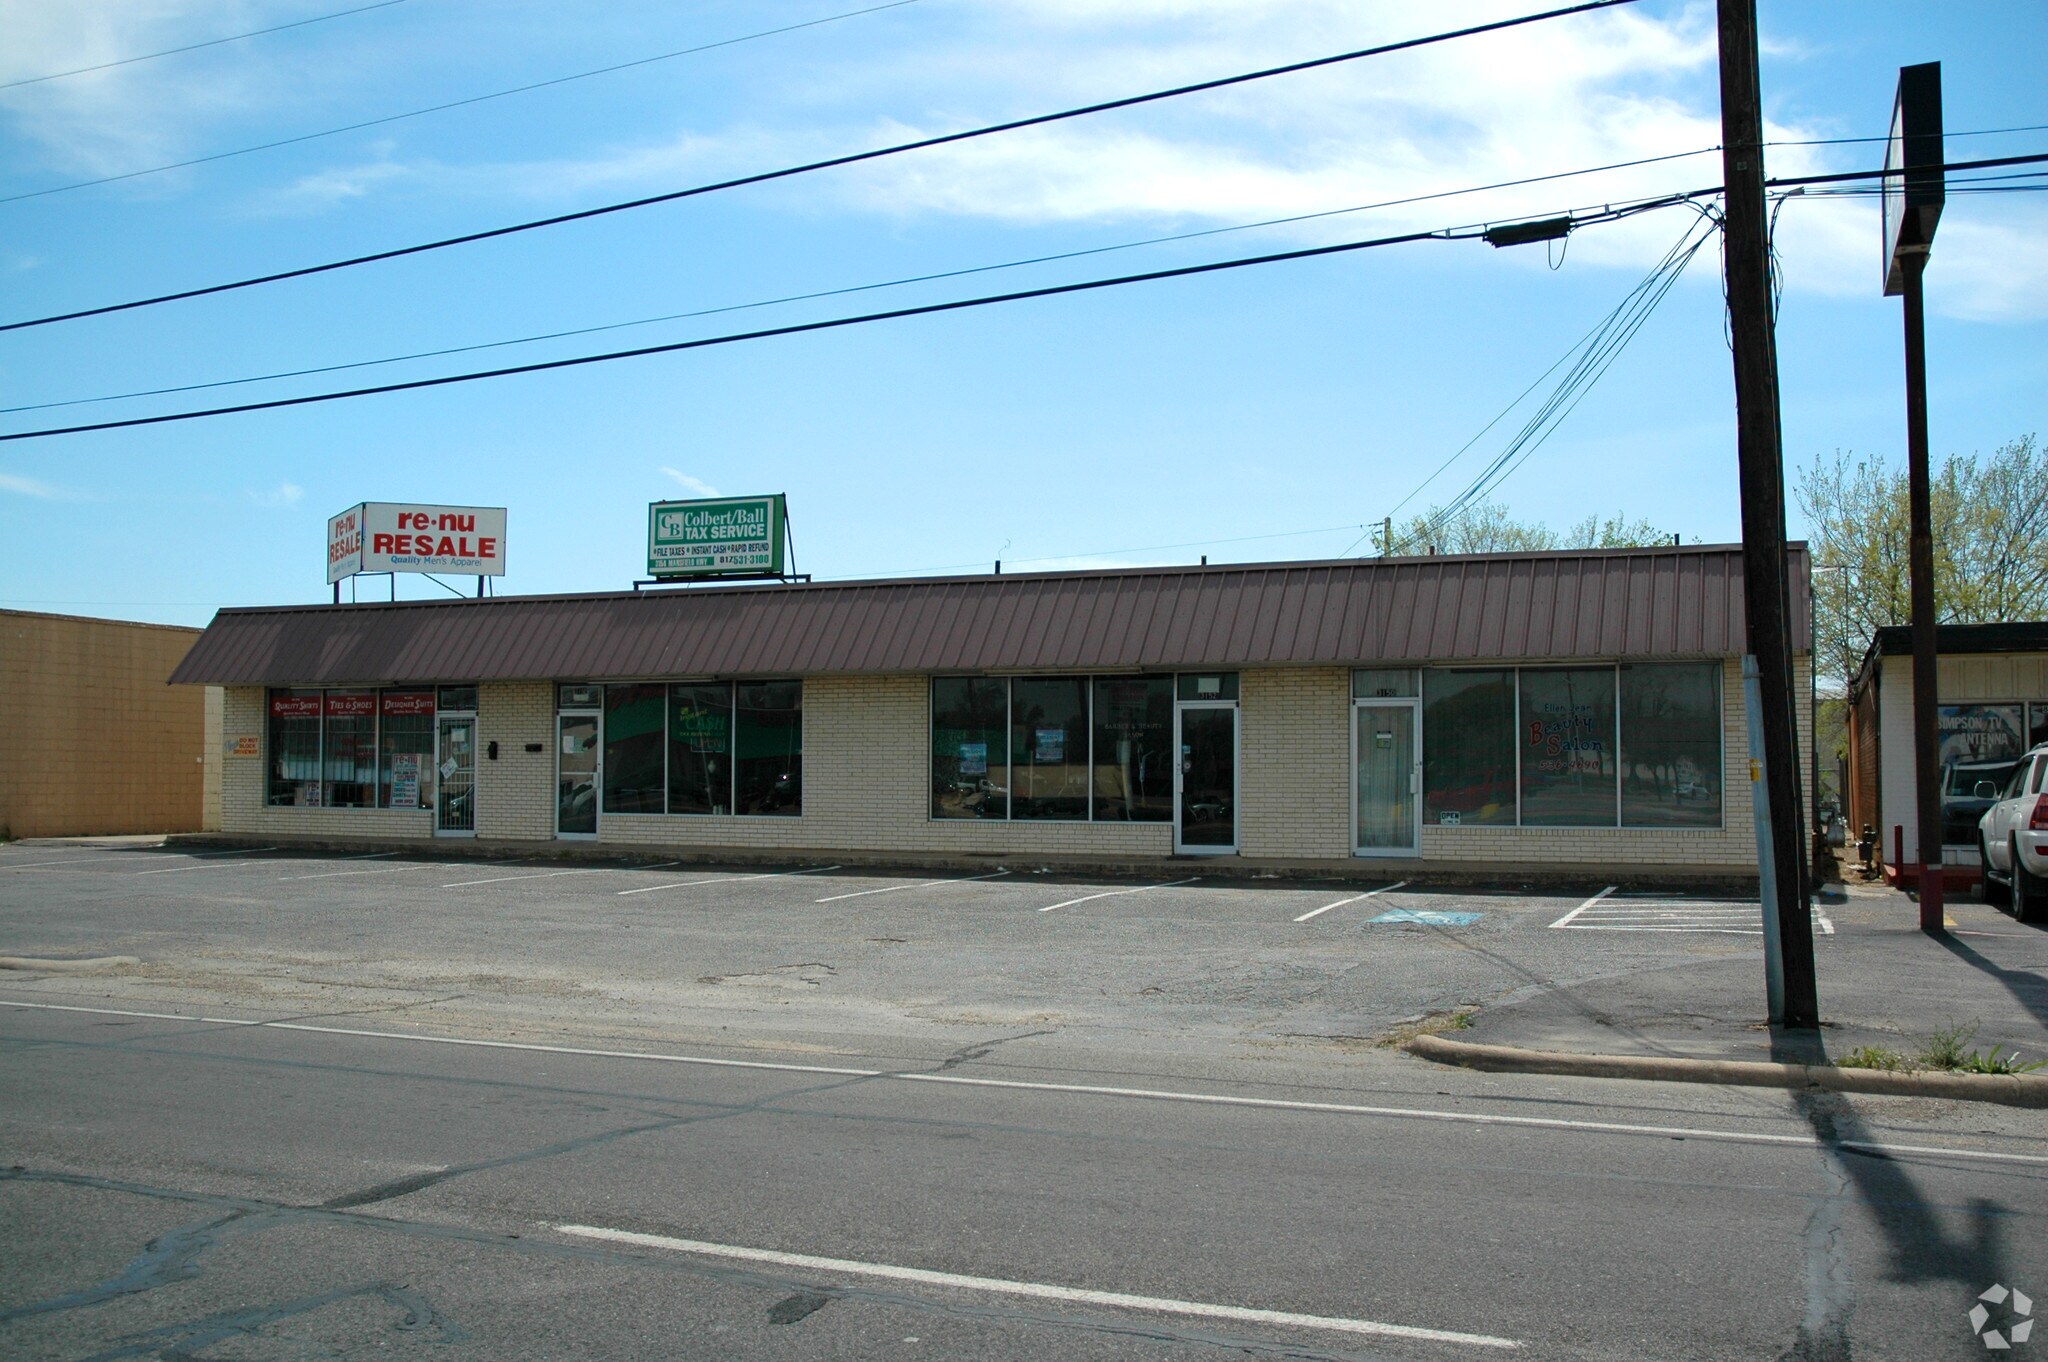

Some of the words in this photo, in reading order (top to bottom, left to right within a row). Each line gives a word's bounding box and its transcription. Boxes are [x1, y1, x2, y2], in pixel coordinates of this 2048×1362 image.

[685, 509, 764, 526] Colbert/Ball
[685, 526, 708, 540] TAX
[710, 524, 765, 539] SERVICE
[330, 531, 361, 564] RESALE
[373, 533, 497, 558] RESALE
[656, 547, 668, 557] FILE
[669, 546, 685, 556] TAXES
[691, 545, 712, 555] INSTANT
[713, 544, 727, 554] CASH
[731, 543, 747, 553] RAPID
[748, 542, 769, 553] REFUND
[391, 555, 421, 566] Quality
[423, 556, 447, 566] Men's
[450, 557, 482, 567] Apparel
[330, 700, 344, 710] TIES
[351, 700, 373, 711] SHOES
[384, 700, 414, 710] DESIGNER
[1544, 703, 1565, 713] Ellen
[1989, 717, 2001, 729] TV
[1528, 714, 1593, 747] Beauty
[1547, 734, 1603, 756] Salon
[1961, 733, 2008, 745] ANTENNA
[1441, 812, 1459, 820] OPEN
